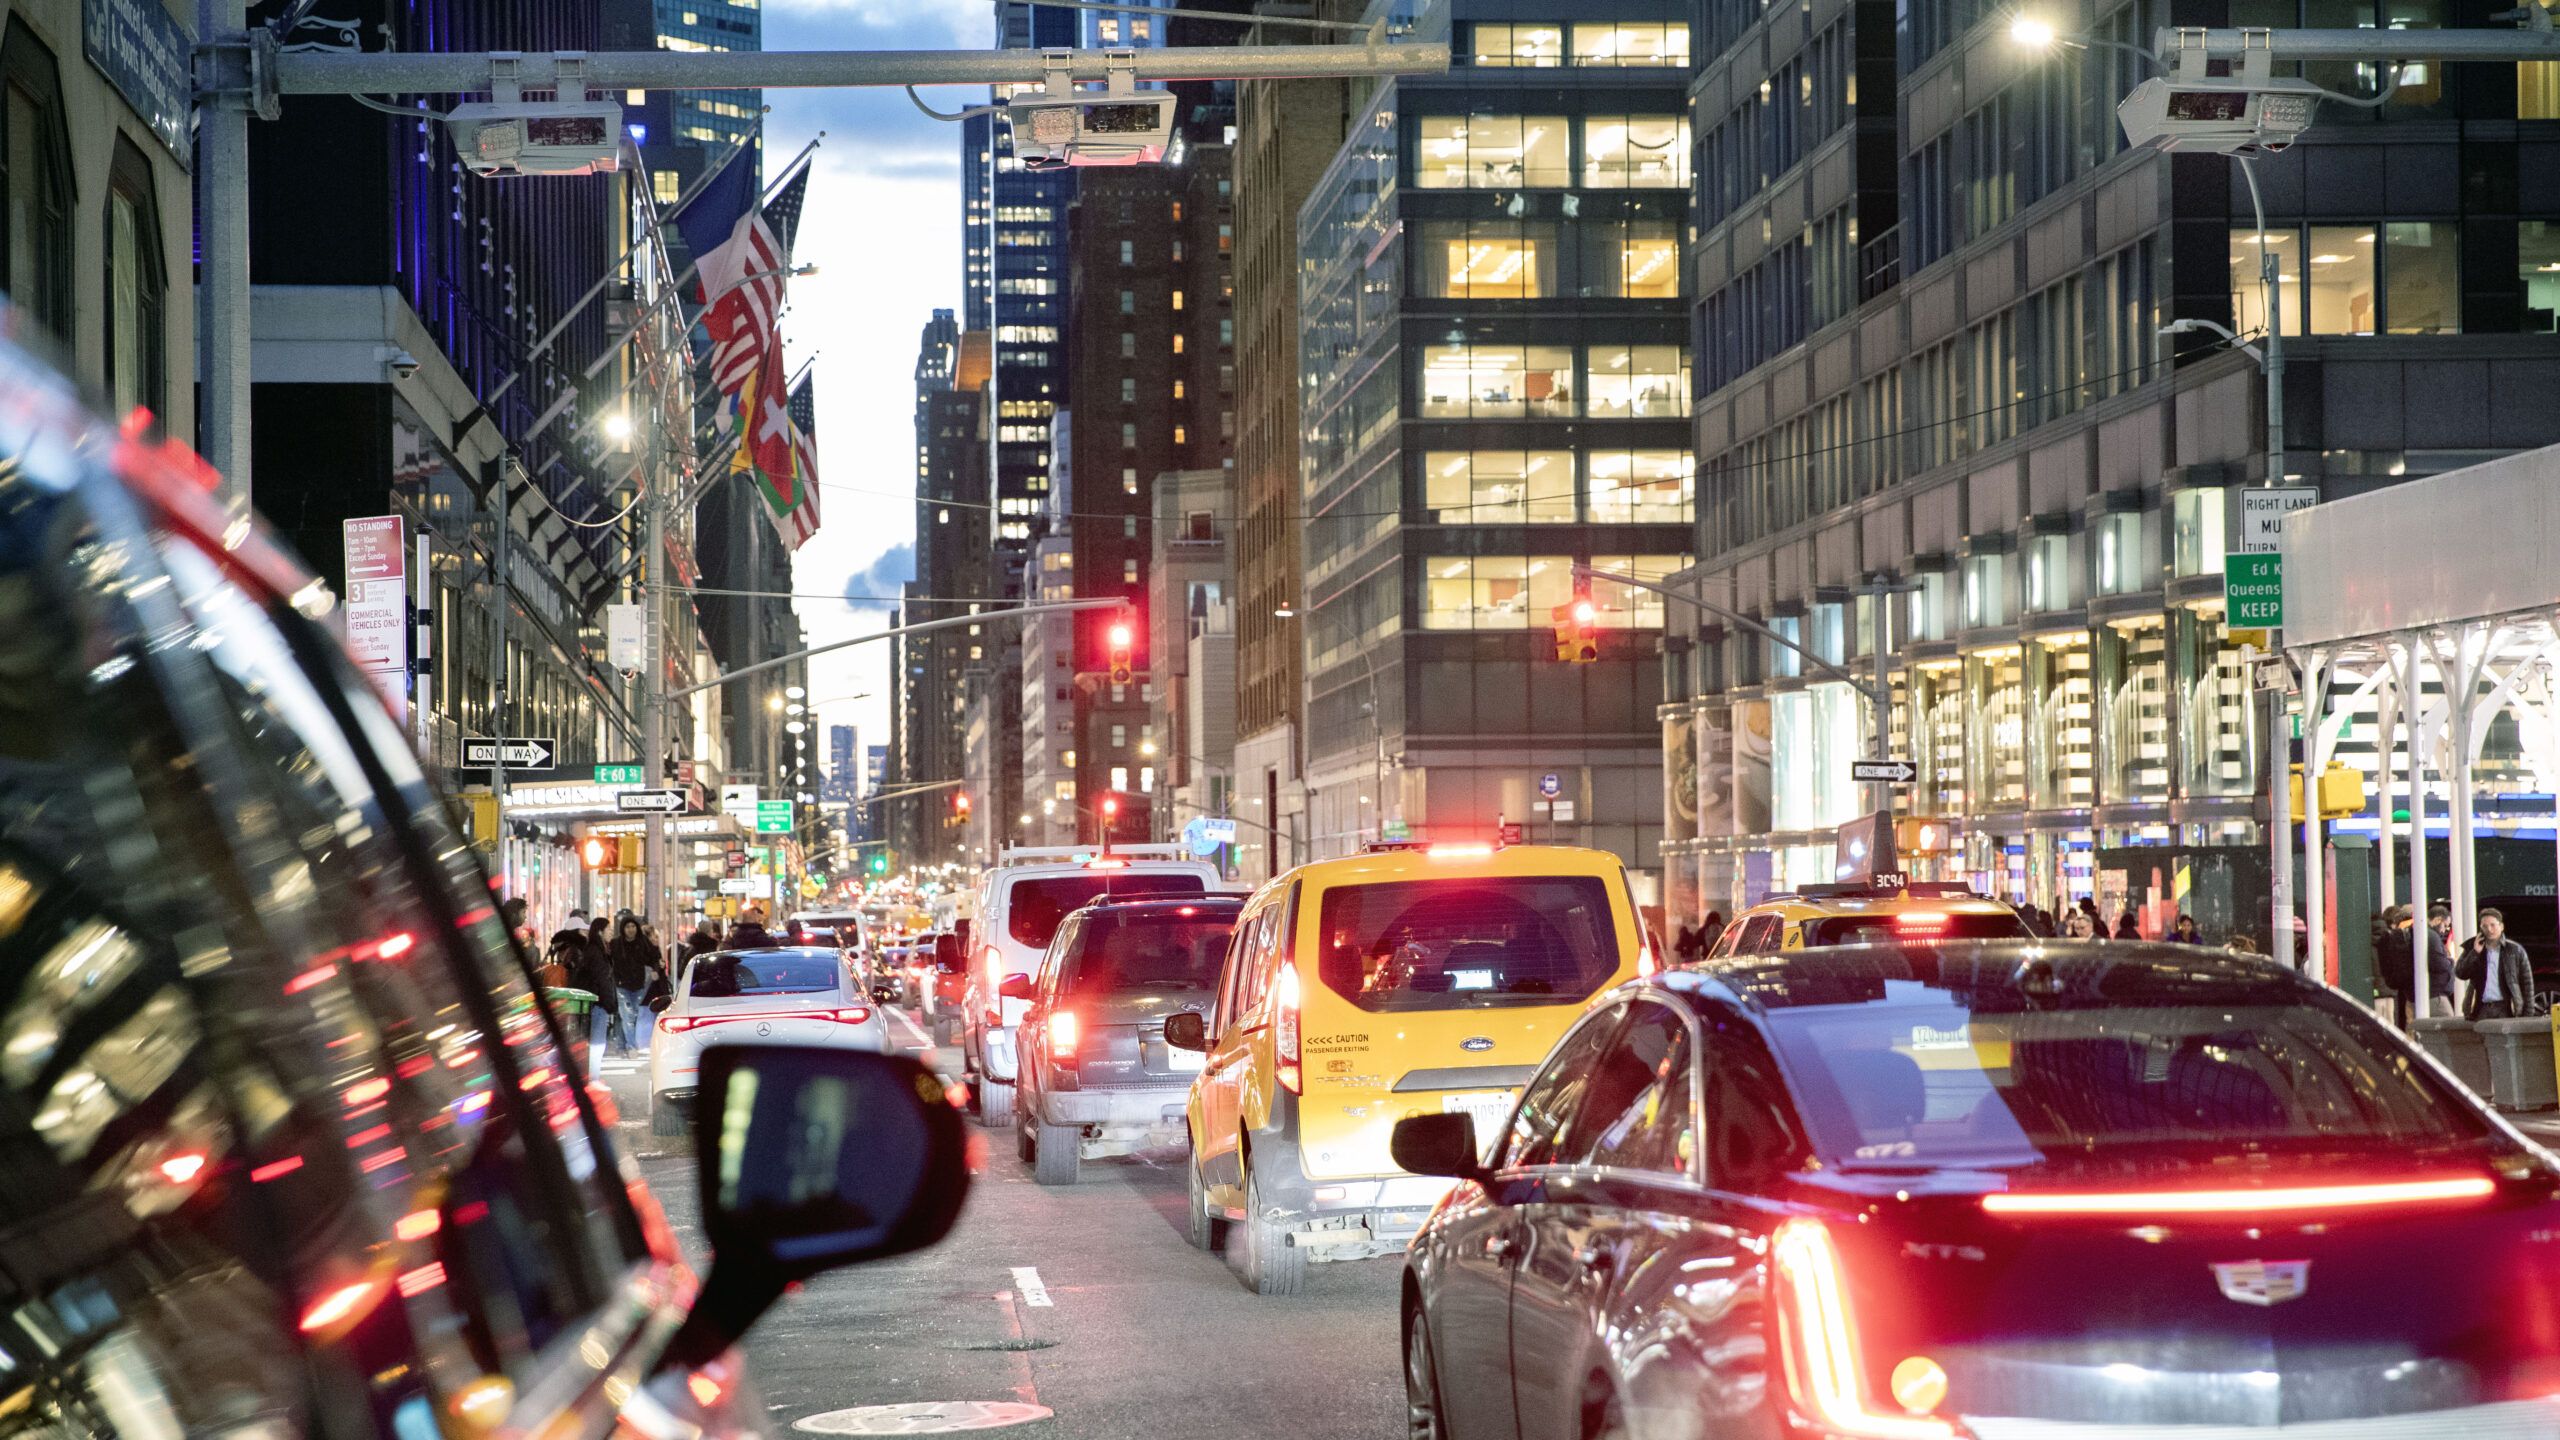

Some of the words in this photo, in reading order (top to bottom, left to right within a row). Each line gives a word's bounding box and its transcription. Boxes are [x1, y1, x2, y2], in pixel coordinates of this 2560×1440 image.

[120, 23, 139, 74] Sports
[140, 48, 166, 108] Medicine
[2246, 499, 2280, 510] RIGHT
[347, 523, 357, 533] NO
[359, 520, 393, 532] STANDING
[363, 536, 377, 544] 10am
[365, 545, 376, 553] 7pm
[349, 554, 366, 562] Except
[368, 552, 386, 561] Sunday
[2252, 562, 2267, 576] Ed
[352, 584, 360, 602] 3
[2229, 583, 2280, 597] Queens
[350, 608, 393, 620] COMMERCIAL
[2241, 602, 2279, 618] KEEP
[351, 620, 381, 630] VEHICLES
[383, 618, 400, 628] ONLY
[371, 644, 389, 652] Sunday
[513, 748, 540, 759] WAY
[600, 768, 607, 781] E
[611, 768, 625, 781] 60
[1860, 767, 1879, 776] ONE
[1887, 768, 1907, 776] WAY
[626, 797, 647, 806] ONE
[655, 797, 675, 806] WAY
[1877, 874, 1904, 887] 3C94
[2525, 885, 2555, 896] POST
[1336, 1034, 1369, 1043] CAUTION
[1344, 1045, 1369, 1053] EXITING
